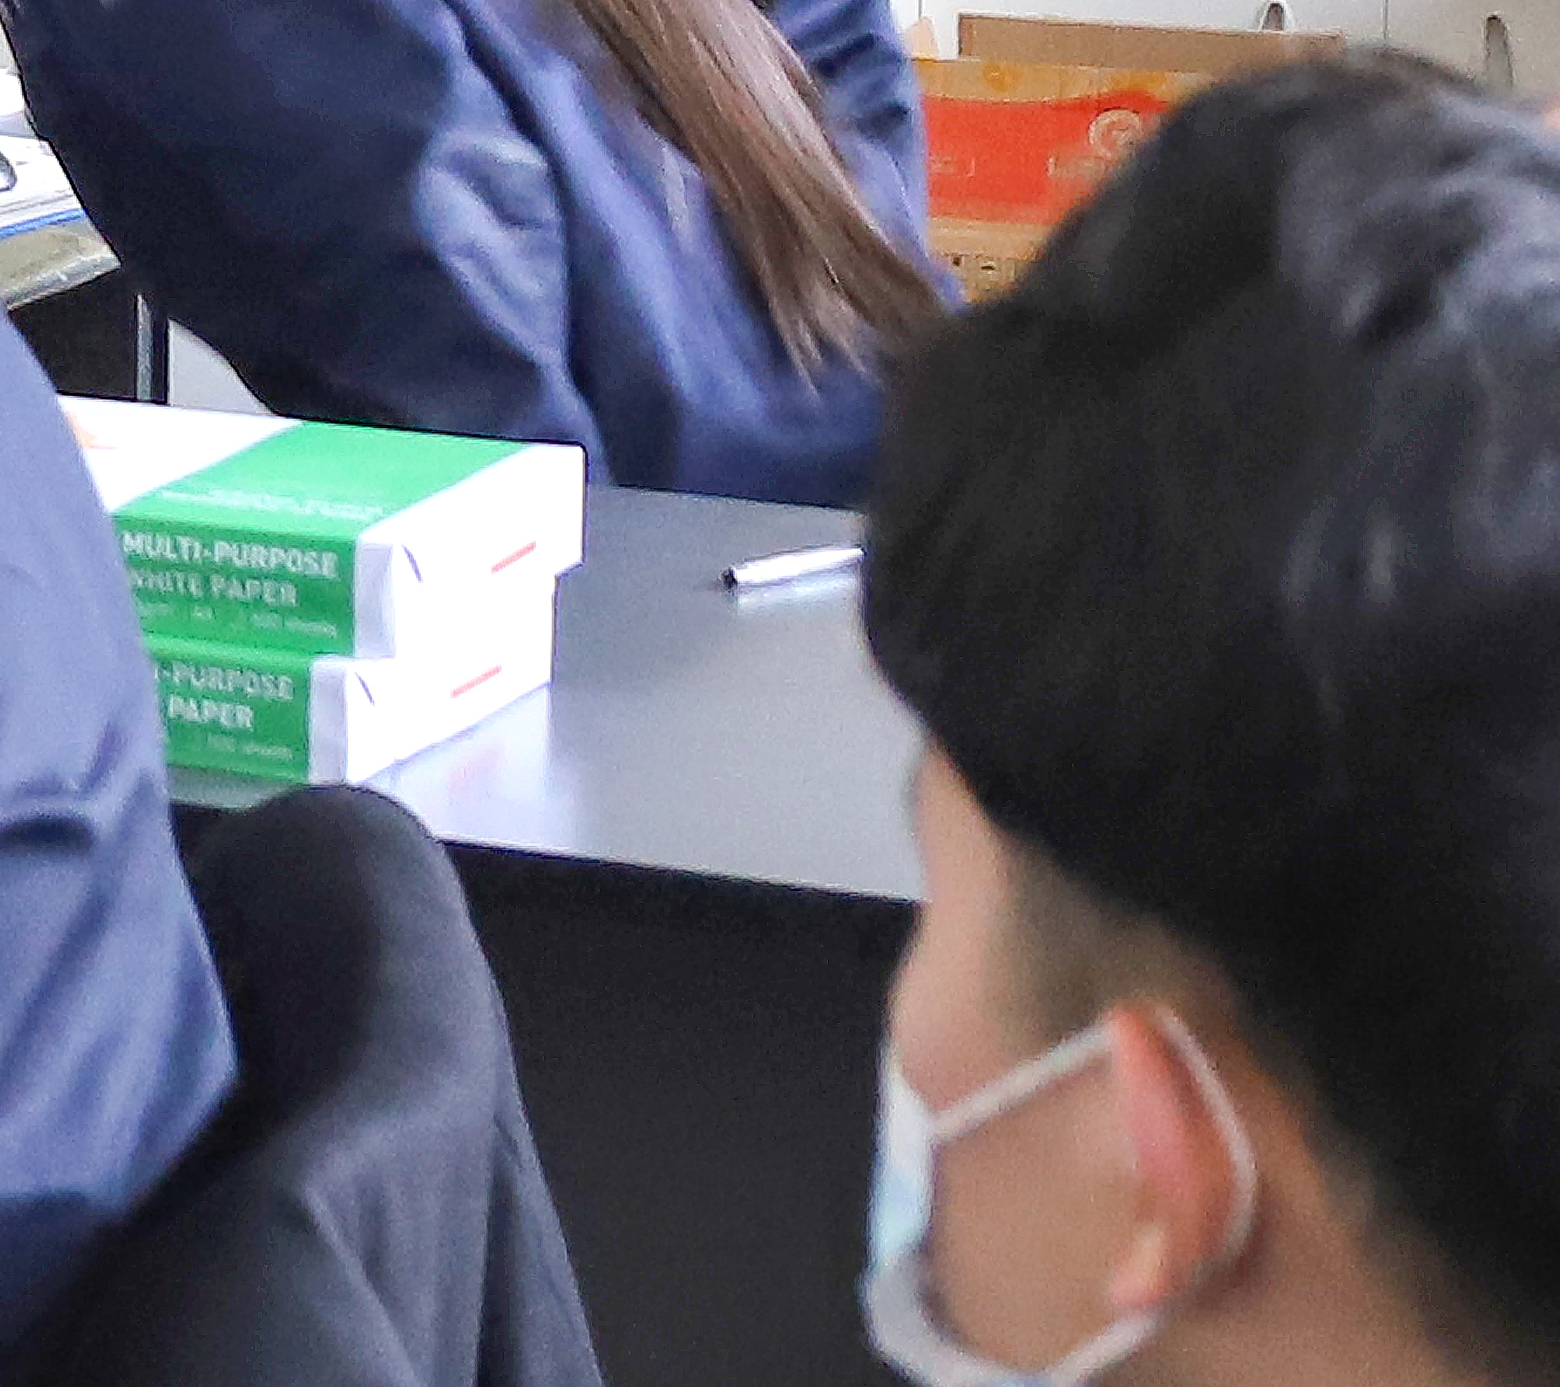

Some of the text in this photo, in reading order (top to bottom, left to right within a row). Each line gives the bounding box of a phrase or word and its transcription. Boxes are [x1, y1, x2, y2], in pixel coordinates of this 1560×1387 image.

[122, 531, 339, 579] MULTI-PURPOSE
[209, 573, 298, 607] PAPER
[168, 693, 255, 733] PAPER
